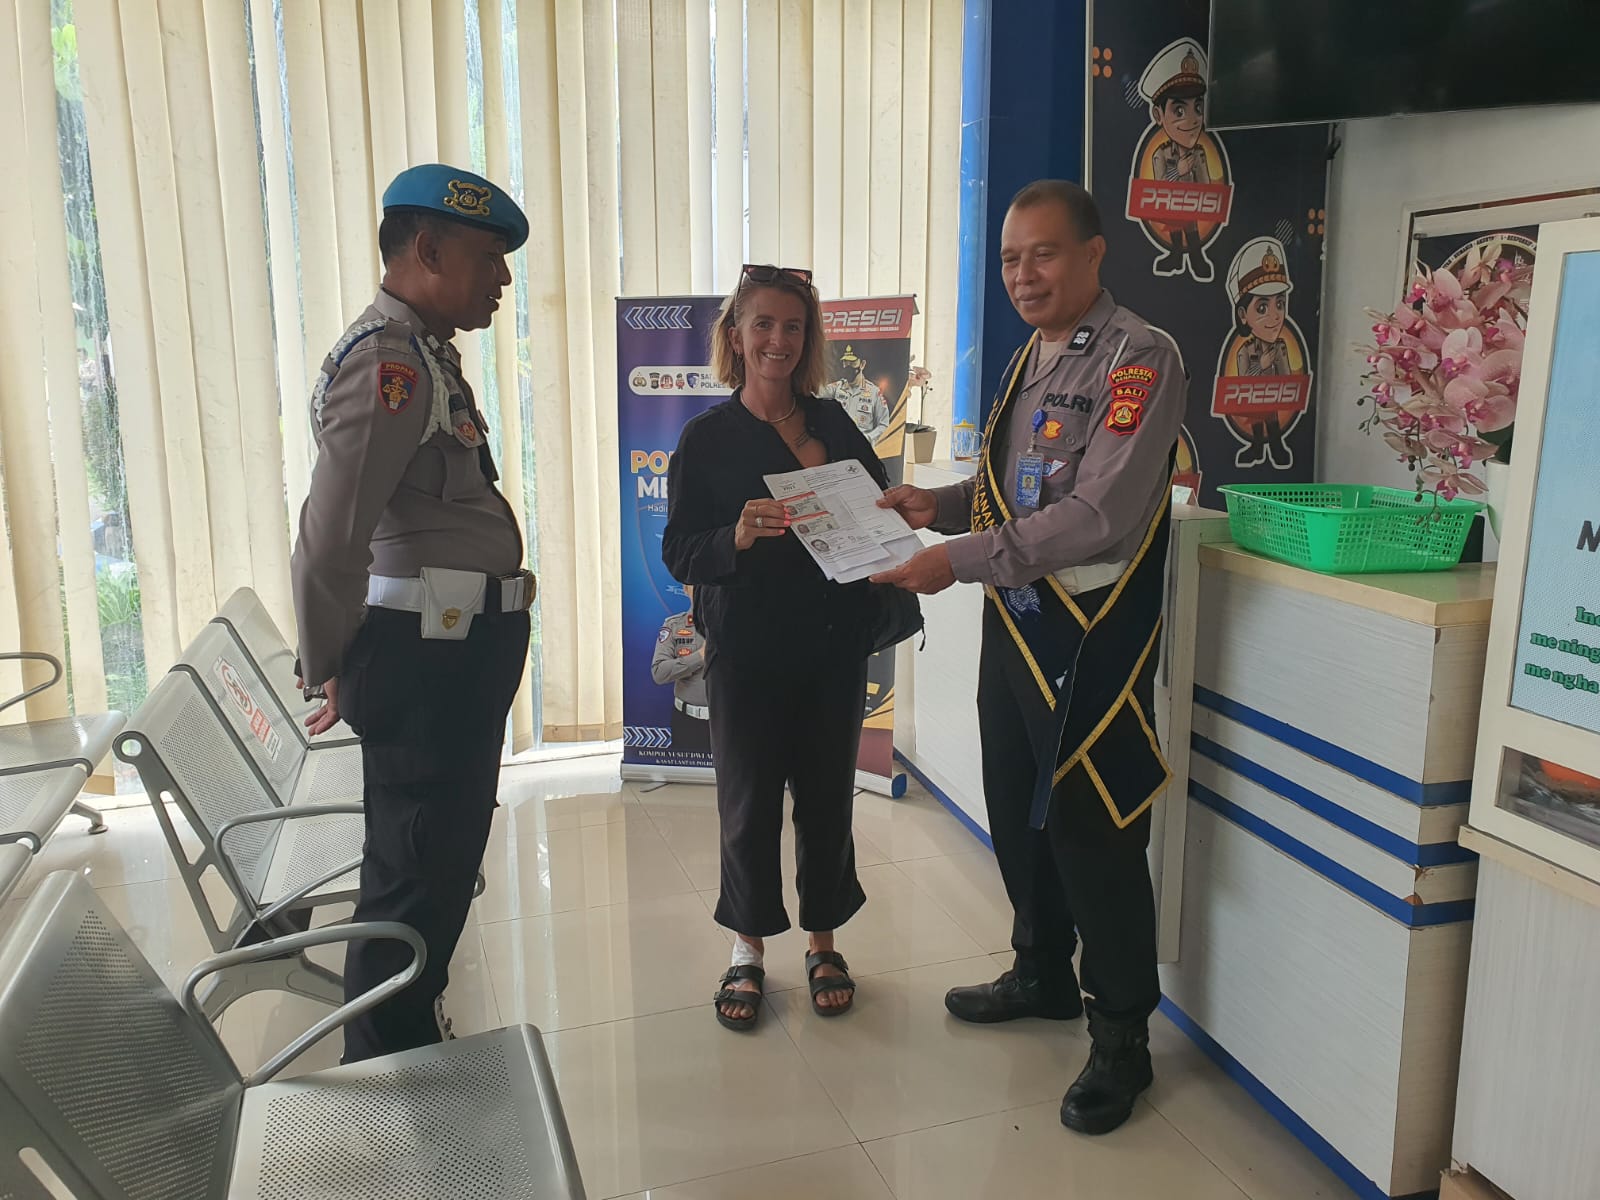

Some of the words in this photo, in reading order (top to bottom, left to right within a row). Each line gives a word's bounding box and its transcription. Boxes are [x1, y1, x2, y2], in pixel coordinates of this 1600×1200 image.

[1140, 187, 1223, 214] PRESISI
[822, 309, 903, 328] PRESISI
[1111, 368, 1154, 380] POLRESTA
[1116, 387, 1143, 397] BALI
[1223, 382, 1302, 405] PRESISI
[1042, 392, 1093, 414] POLRI
